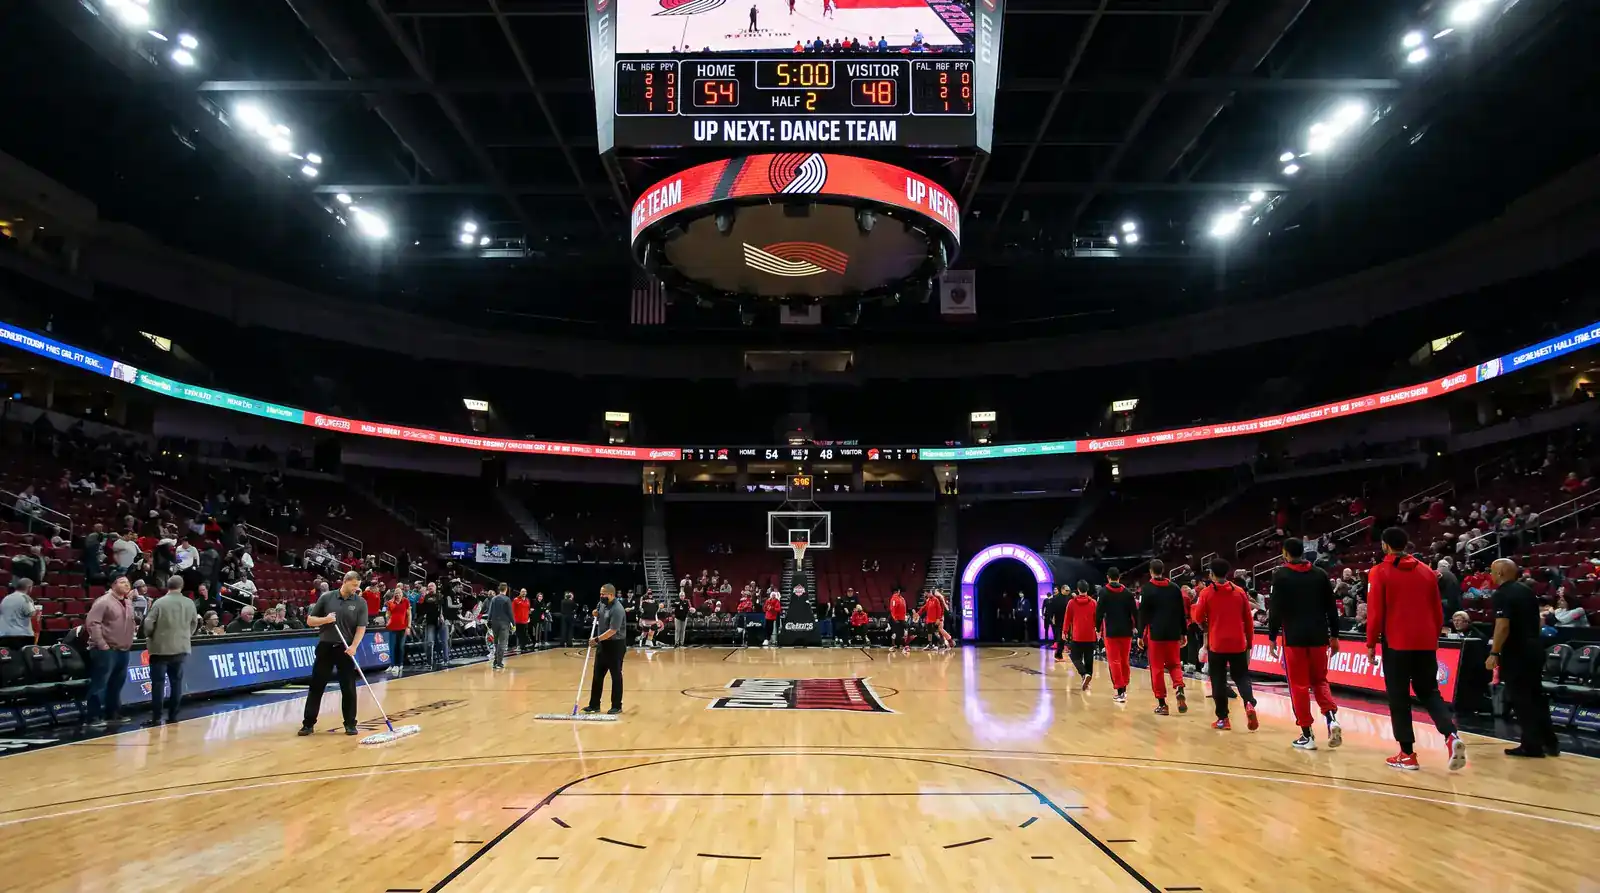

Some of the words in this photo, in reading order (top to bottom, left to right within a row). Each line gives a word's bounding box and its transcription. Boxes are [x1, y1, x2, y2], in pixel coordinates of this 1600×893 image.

[621, 63, 637, 71] FAL
[697, 64, 736, 77] HOME
[777, 64, 829, 86] 5:00
[846, 64, 900, 77] VISITOR
[916, 62, 932, 71] FAL
[704, 82, 733, 104] 54
[771, 96, 801, 107] HALF
[806, 92, 817, 110] 2
[862, 81, 892, 104] 48
[693, 120, 719, 141] UP
[723, 120, 775, 141] NEXT:
[780, 120, 841, 141] DANCE
[845, 120, 897, 141] TEAM
[647, 179, 683, 217] TEAM
[906, 177, 926, 204] UP
[765, 449, 779, 460] 54
[819, 449, 833, 460] 48
[208, 653, 238, 679] THE
